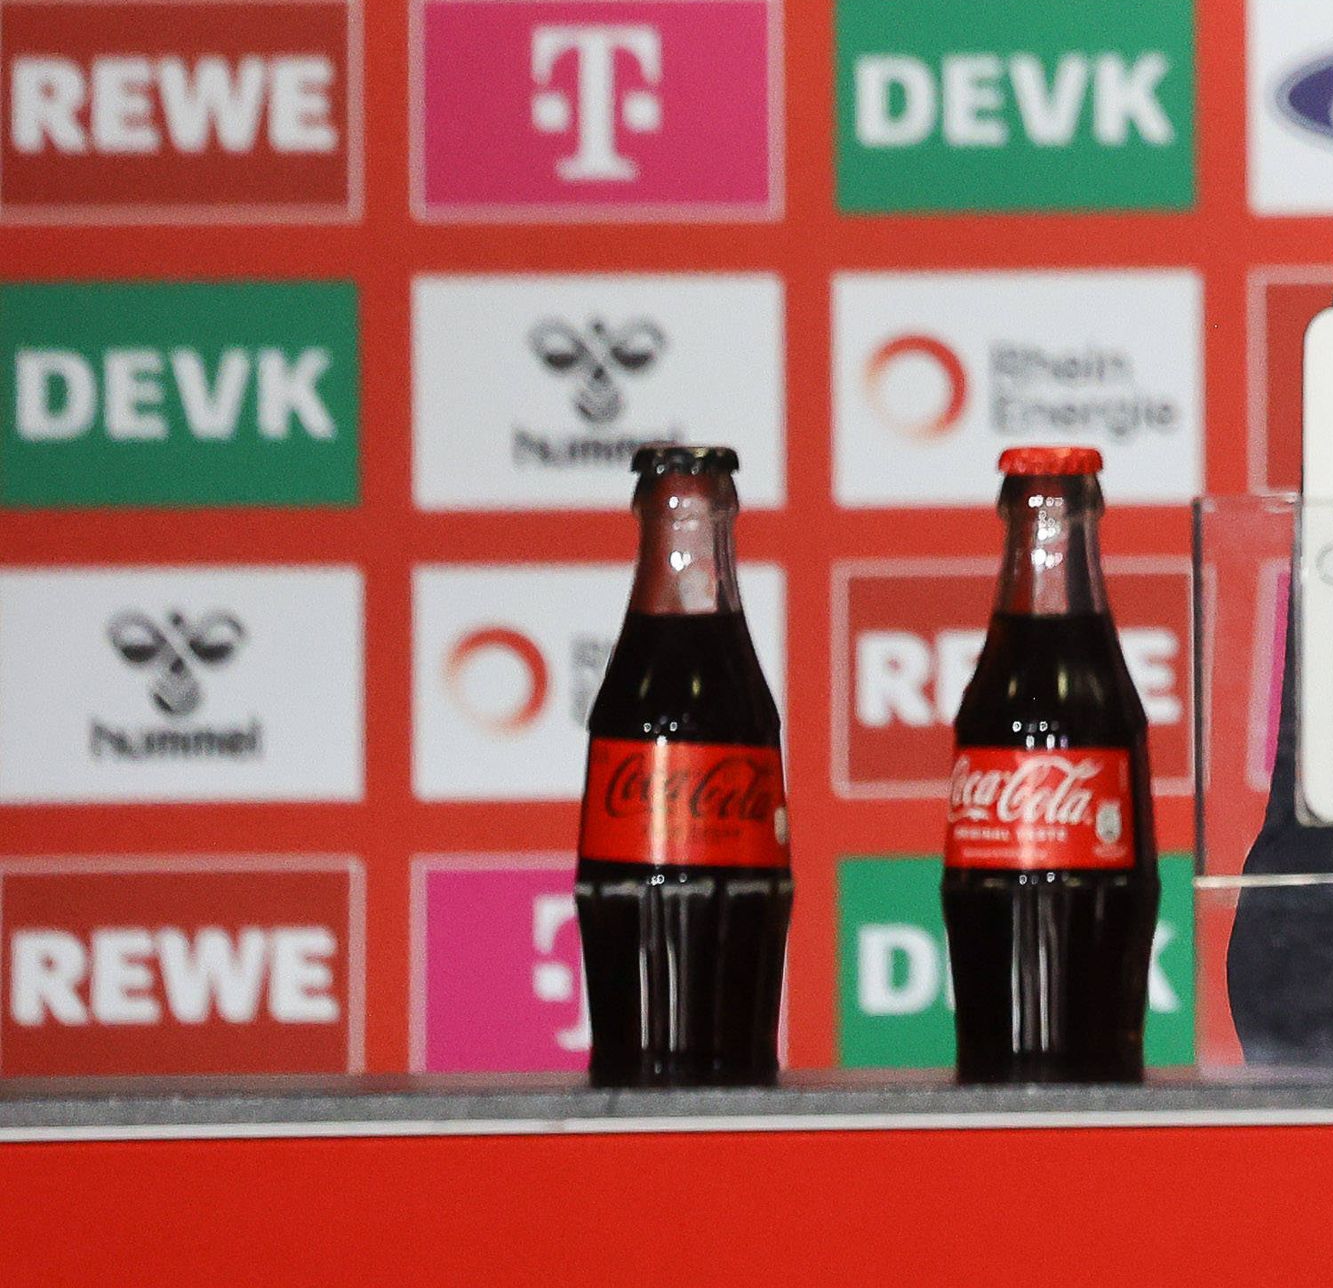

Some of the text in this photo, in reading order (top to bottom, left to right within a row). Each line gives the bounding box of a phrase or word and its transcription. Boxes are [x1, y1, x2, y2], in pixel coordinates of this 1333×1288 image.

[12, 56, 337, 152] REWE
[855, 53, 1172, 146] DEVK
[16, 349, 334, 440] DEVK
[90, 712, 261, 761] hummel
[12, 927, 339, 1025] REWE
